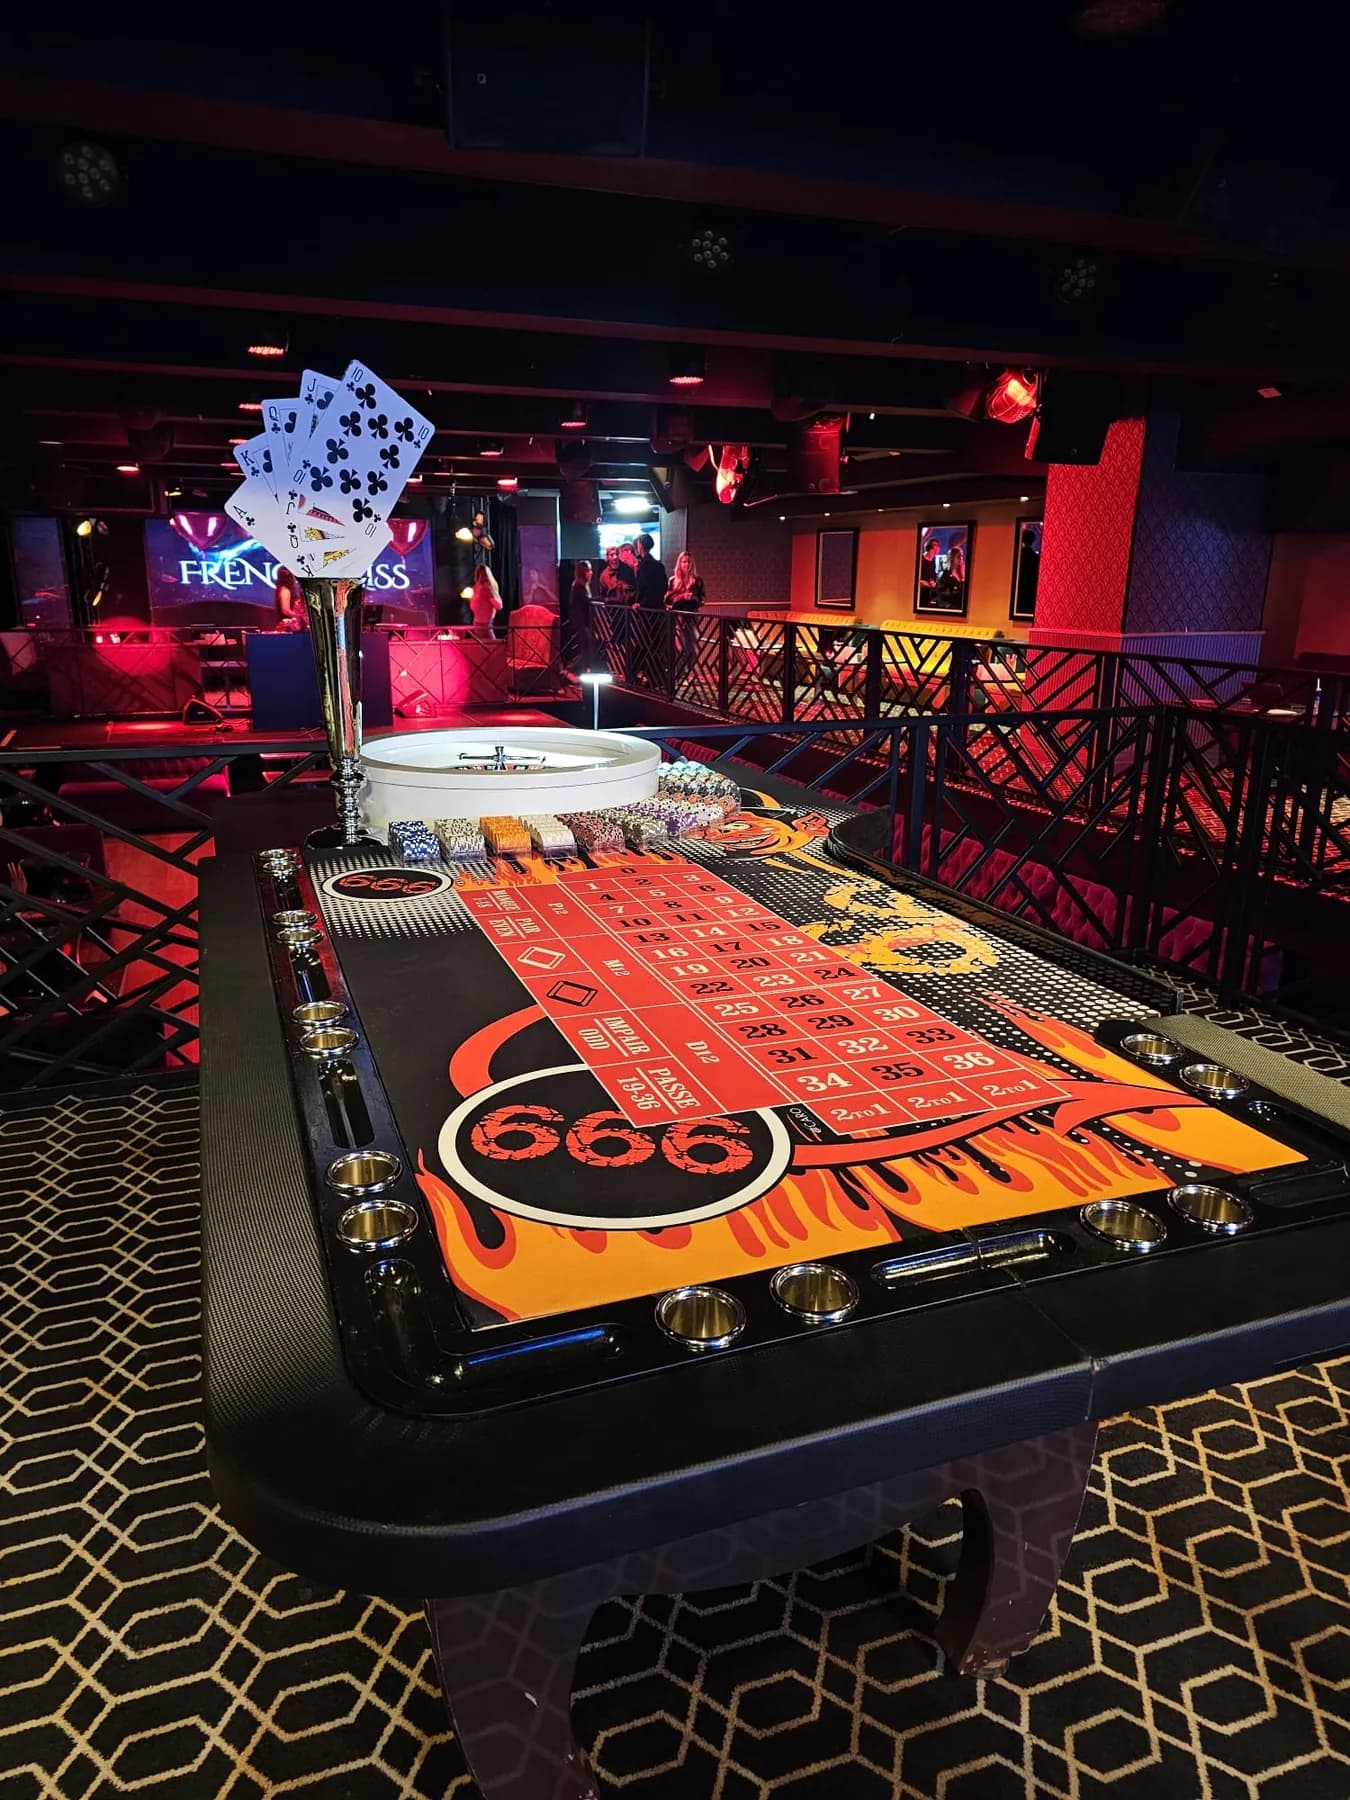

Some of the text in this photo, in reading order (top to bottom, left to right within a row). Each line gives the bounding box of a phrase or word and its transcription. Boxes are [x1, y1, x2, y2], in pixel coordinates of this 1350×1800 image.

[351, 366, 364, 382] 10
[307, 378, 316, 392] J
[268, 406, 278, 422] Q
[417, 425, 430, 440] 10
[240, 450, 254, 466] K
[293, 469, 306, 485] 10
[233, 504, 247, 519] A
[364, 522, 377, 538] 10
[363, 563, 410, 591] ISS
[338, 874, 440, 894] 666
[635, 878, 652, 886] 2
[683, 874, 700, 882] 3
[586, 882, 600, 890] 1
[648, 889, 667, 898] 5
[715, 896, 734, 904] 9
[608, 906, 625, 914] 7
[674, 913, 707, 922] 11
[726, 908, 760, 918] 12
[489, 919, 517, 936] EVEN
[516, 918, 541, 934] PAIR
[618, 918, 652, 928] 10
[745, 922, 782, 932] 15
[634, 932, 671, 944] 13
[690, 927, 728, 938] 14
[710, 942, 742, 953] 17
[767, 936, 804, 946] 18
[651, 948, 689, 960] 16
[790, 951, 830, 963] 21
[670, 964, 710, 977] 19
[730, 957, 771, 969] 20
[752, 974, 796, 988] 23
[813, 967, 858, 980] 24
[690, 982, 734, 995] 22
[842, 986, 882, 1001] 27
[779, 994, 825, 1008] 26
[714, 1002, 760, 1017] 25
[872, 1006, 921, 1022] 30
[807, 1014, 855, 1030] 29
[602, 1016, 650, 1055] IMPAIR
[738, 1023, 788, 1039] 28
[906, 1028, 956, 1044] 33
[577, 1028, 610, 1050] ODD
[836, 1036, 890, 1054] 32
[685, 1040, 720, 1064] D12
[767, 1047, 819, 1064] 31
[942, 1052, 996, 1070] 36
[871, 1062, 925, 1081] 35
[648, 1067, 702, 1109] PASSE
[796, 1072, 854, 1092] 34
[616, 1076, 662, 1110] 19-36
[470, 1104, 754, 1175] 666
